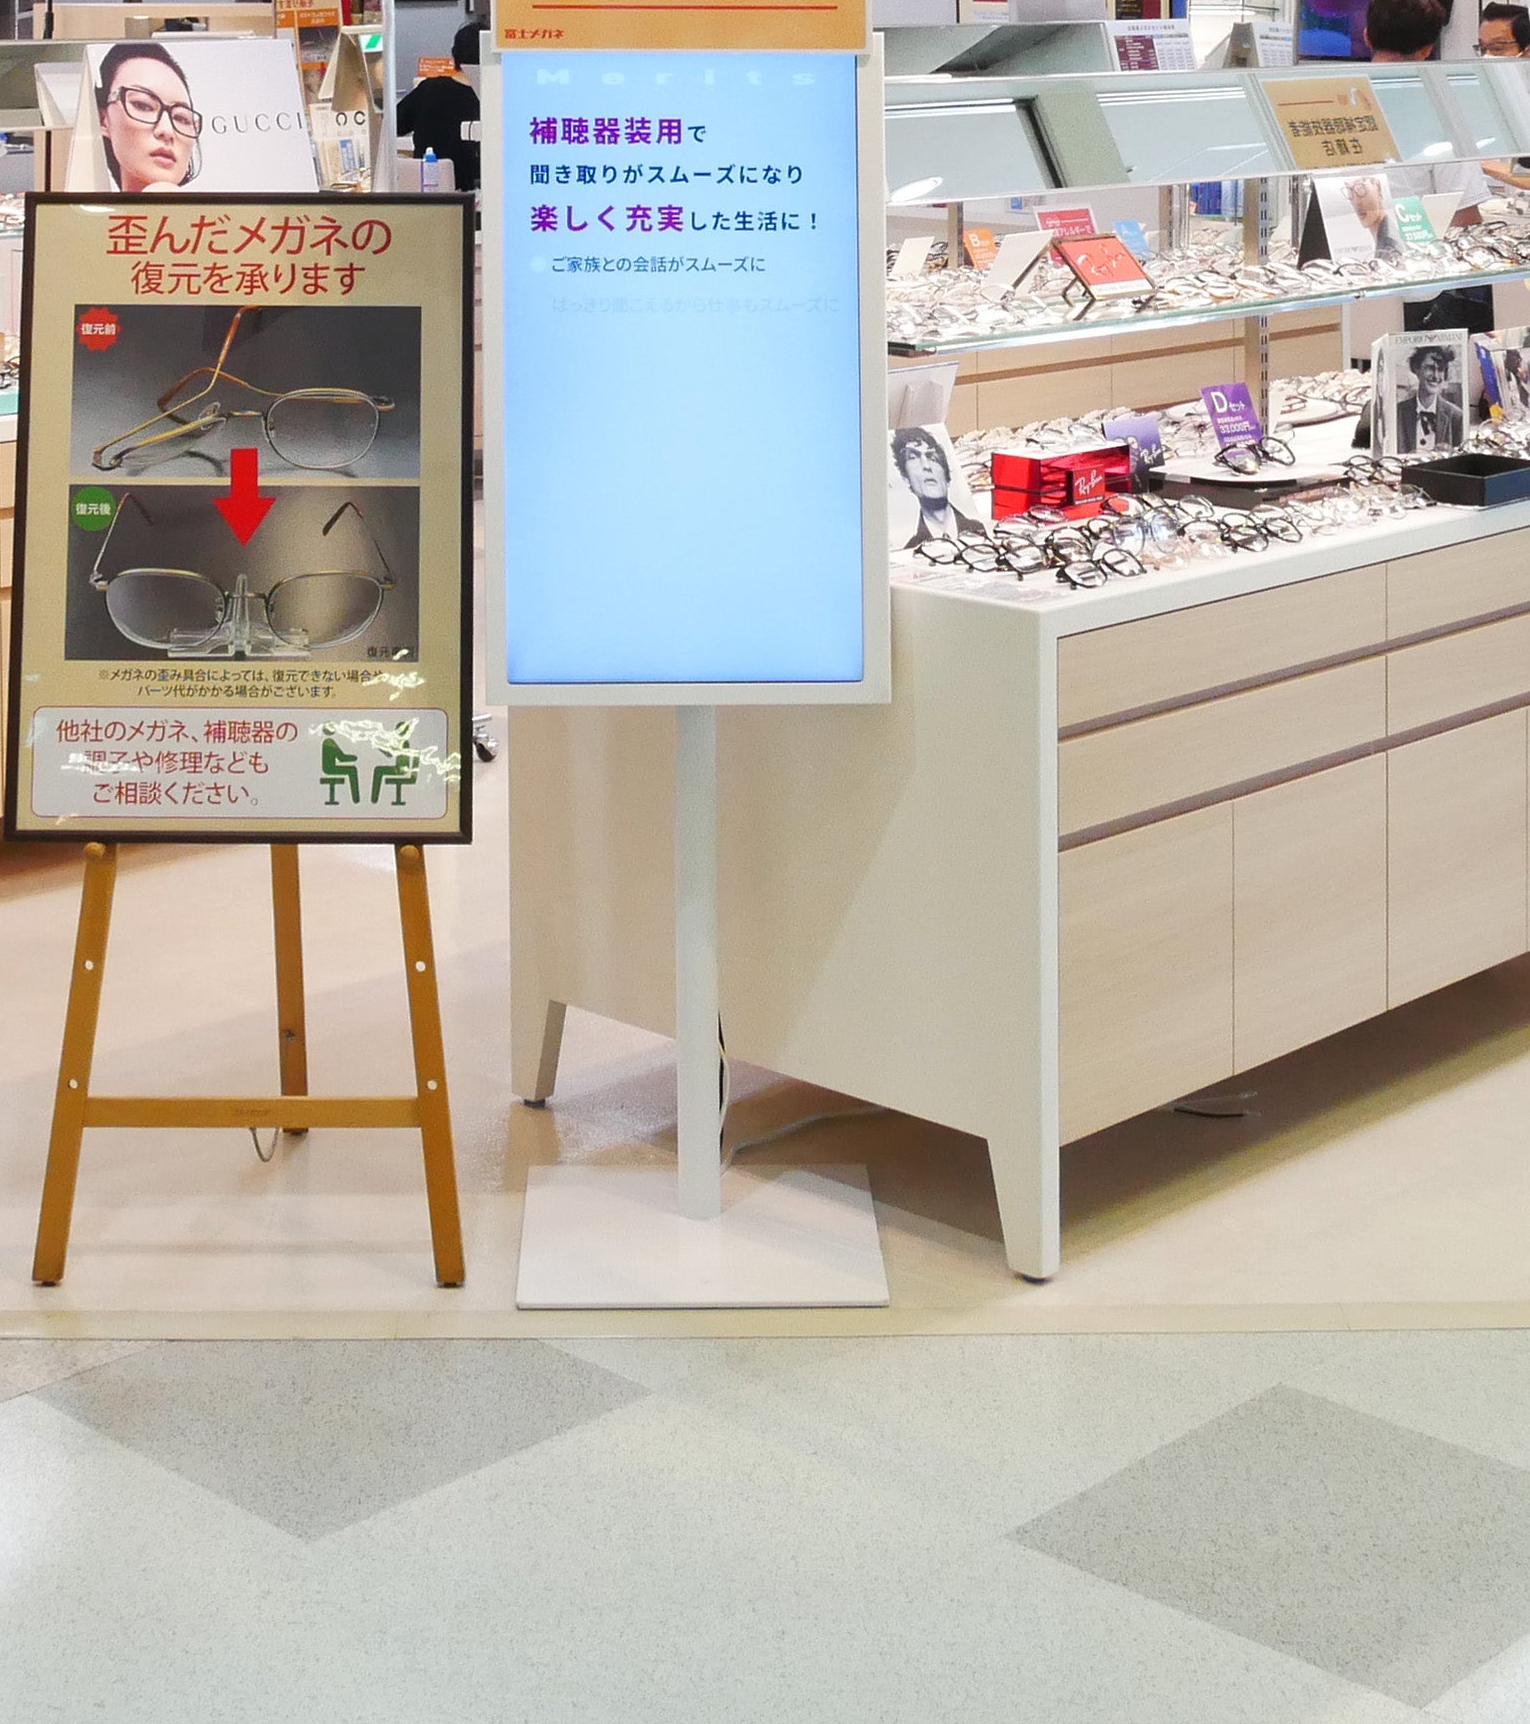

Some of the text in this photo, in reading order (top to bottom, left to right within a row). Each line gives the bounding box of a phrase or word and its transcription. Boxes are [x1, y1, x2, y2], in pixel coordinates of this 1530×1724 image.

[211, 111, 303, 134] GUCCI
[529, 117, 707, 145] 補聴器装用で
[529, 164, 804, 185] 聞き取りがスムーズになり
[106, 214, 393, 257] 歪んだメガネの
[551, 255, 766, 273] ご家族との会話がスムーズに
[130, 260, 366, 296] 復元を承ります
[80, 322, 117, 337] 復元前
[75, 502, 112, 516] 復元後
[56, 718, 298, 745] 他社のメガネ、補聴器の
[93, 781, 260, 807] ご相談ください。
